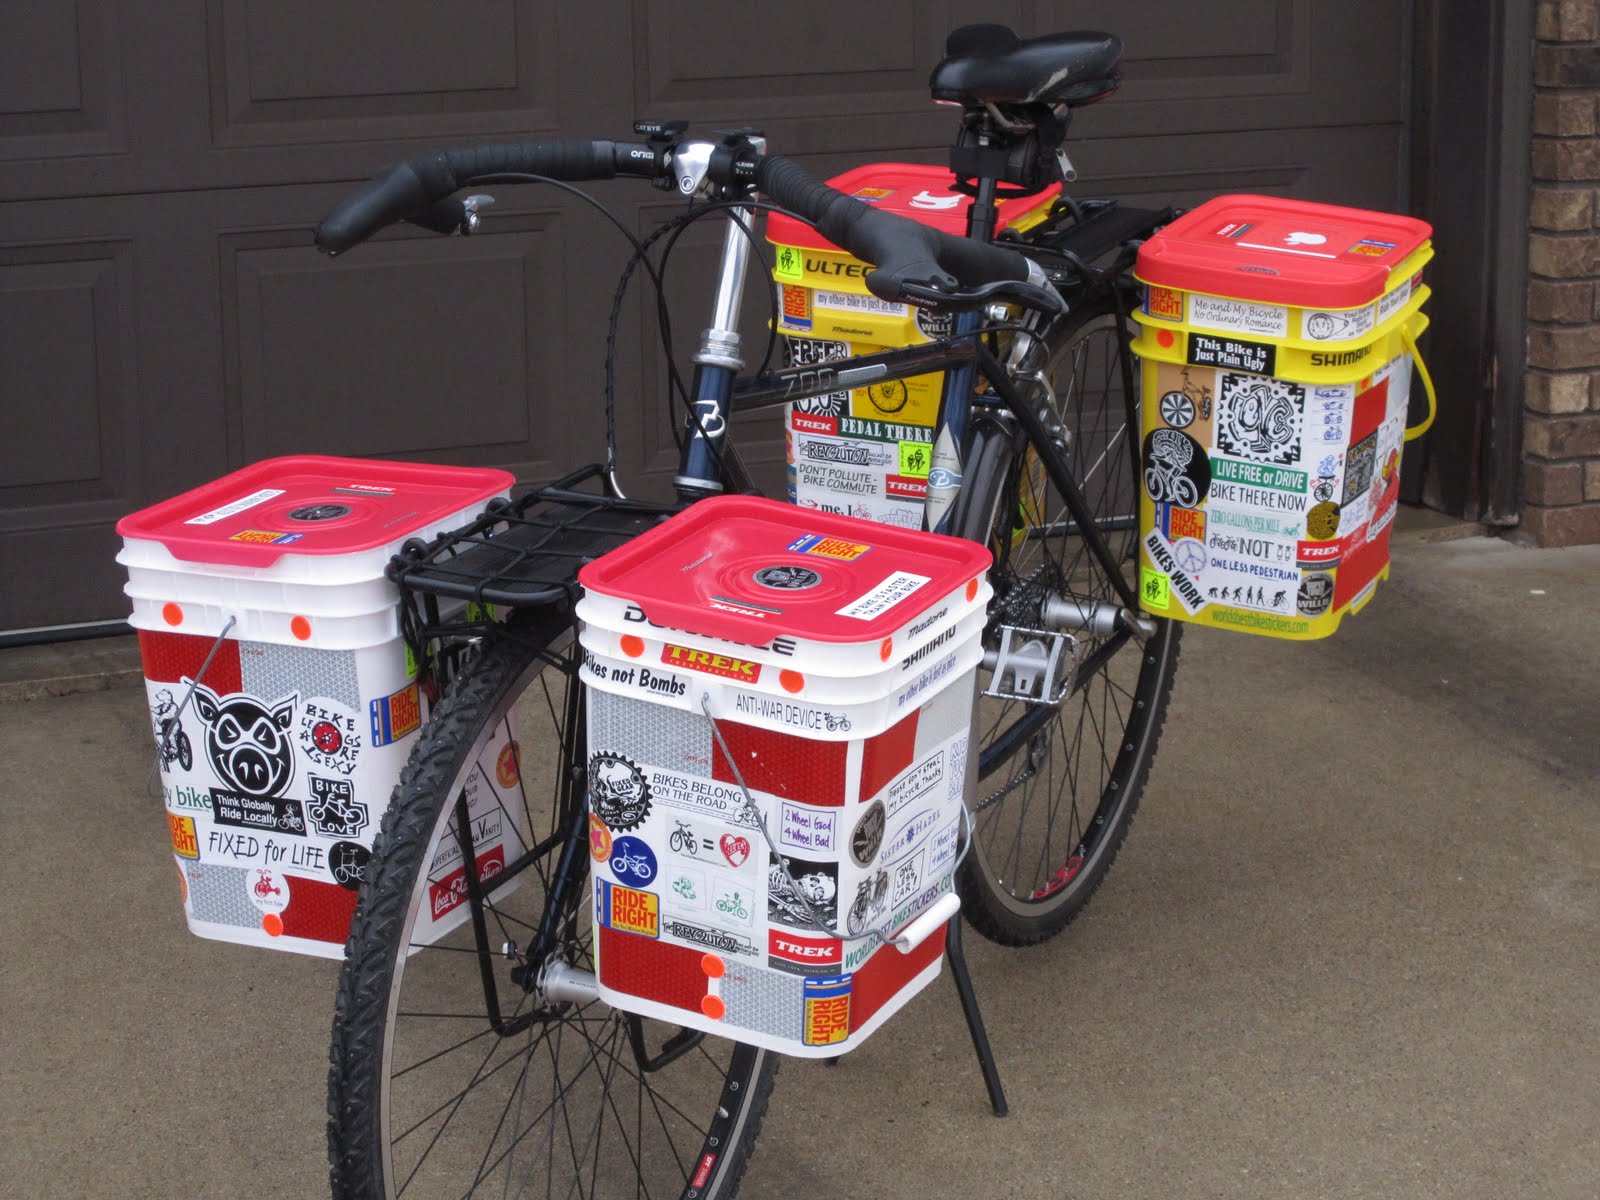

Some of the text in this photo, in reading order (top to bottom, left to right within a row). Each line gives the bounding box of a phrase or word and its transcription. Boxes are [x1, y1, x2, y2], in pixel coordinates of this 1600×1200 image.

[818, 294, 827, 305] my
[828, 293, 845, 306] other
[847, 294, 860, 308] bike
[868, 296, 880, 311] just
[1150, 298, 1181, 315] RIGHT
[1194, 299, 1283, 321] Me and My Bicycle
[920, 323, 952, 332] WILLI
[1194, 310, 1282, 330] No Ordinary Romance
[1195, 337, 1267, 358] This Bike is
[1195, 348, 1266, 371] Just Plain Ugly
[794, 418, 832, 431] TREK
[841, 417, 932, 443] PEDAL THERE
[803, 475, 878, 495] BIKE COMMUTE
[828, 468, 872, 484] POLLUTE
[1216, 460, 1304, 490] LIVE FREE or DRIVE
[887, 481, 928, 493] TREK
[1210, 482, 1307, 513] BIKE THERE NOW
[1170, 508, 1198, 524] RIDE
[1169, 522, 1205, 540] RIGHT
[811, 543, 862, 560] RIGHT
[821, 537, 859, 550] RIDE
[1238, 536, 1275, 559] NOT
[1302, 545, 1340, 556] TREK
[1146, 534, 1206, 610] BIKES WORK
[1210, 557, 1228, 569] ONE
[1229, 560, 1248, 574] LESS
[1249, 564, 1299, 582] PEDESTRIAN
[667, 644, 756, 675] TREK
[611, 668, 636, 685] not
[638, 668, 686, 696] Bombs
[391, 690, 413, 715] RIDE
[735, 693, 823, 730] ANTI-WAR DEVICE
[391, 704, 421, 735] RIGHT
[315, 780, 349, 795] BIKE
[611, 778, 631, 788] FIXED
[616, 783, 635, 792] GEAR
[652, 773, 742, 803] BIKES BELONG
[175, 785, 213, 809] bike
[216, 794, 276, 813] Think Globally
[652, 785, 727, 810] ON THE ROAD
[220, 806, 278, 828] Ride Locally
[319, 821, 354, 835] LOVE
[784, 809, 832, 832] 2 Wheel Good
[783, 827, 830, 848] 4 Wheel Bad
[209, 831, 326, 870] FIXED for LIFE
[430, 843, 459, 872] UPERFICIAL
[612, 887, 649, 911] RIDE
[612, 906, 657, 929] RIGHT
[775, 939, 834, 958] TREK
[812, 999, 832, 1044] RIGHT
[830, 995, 849, 1035] RIDE
